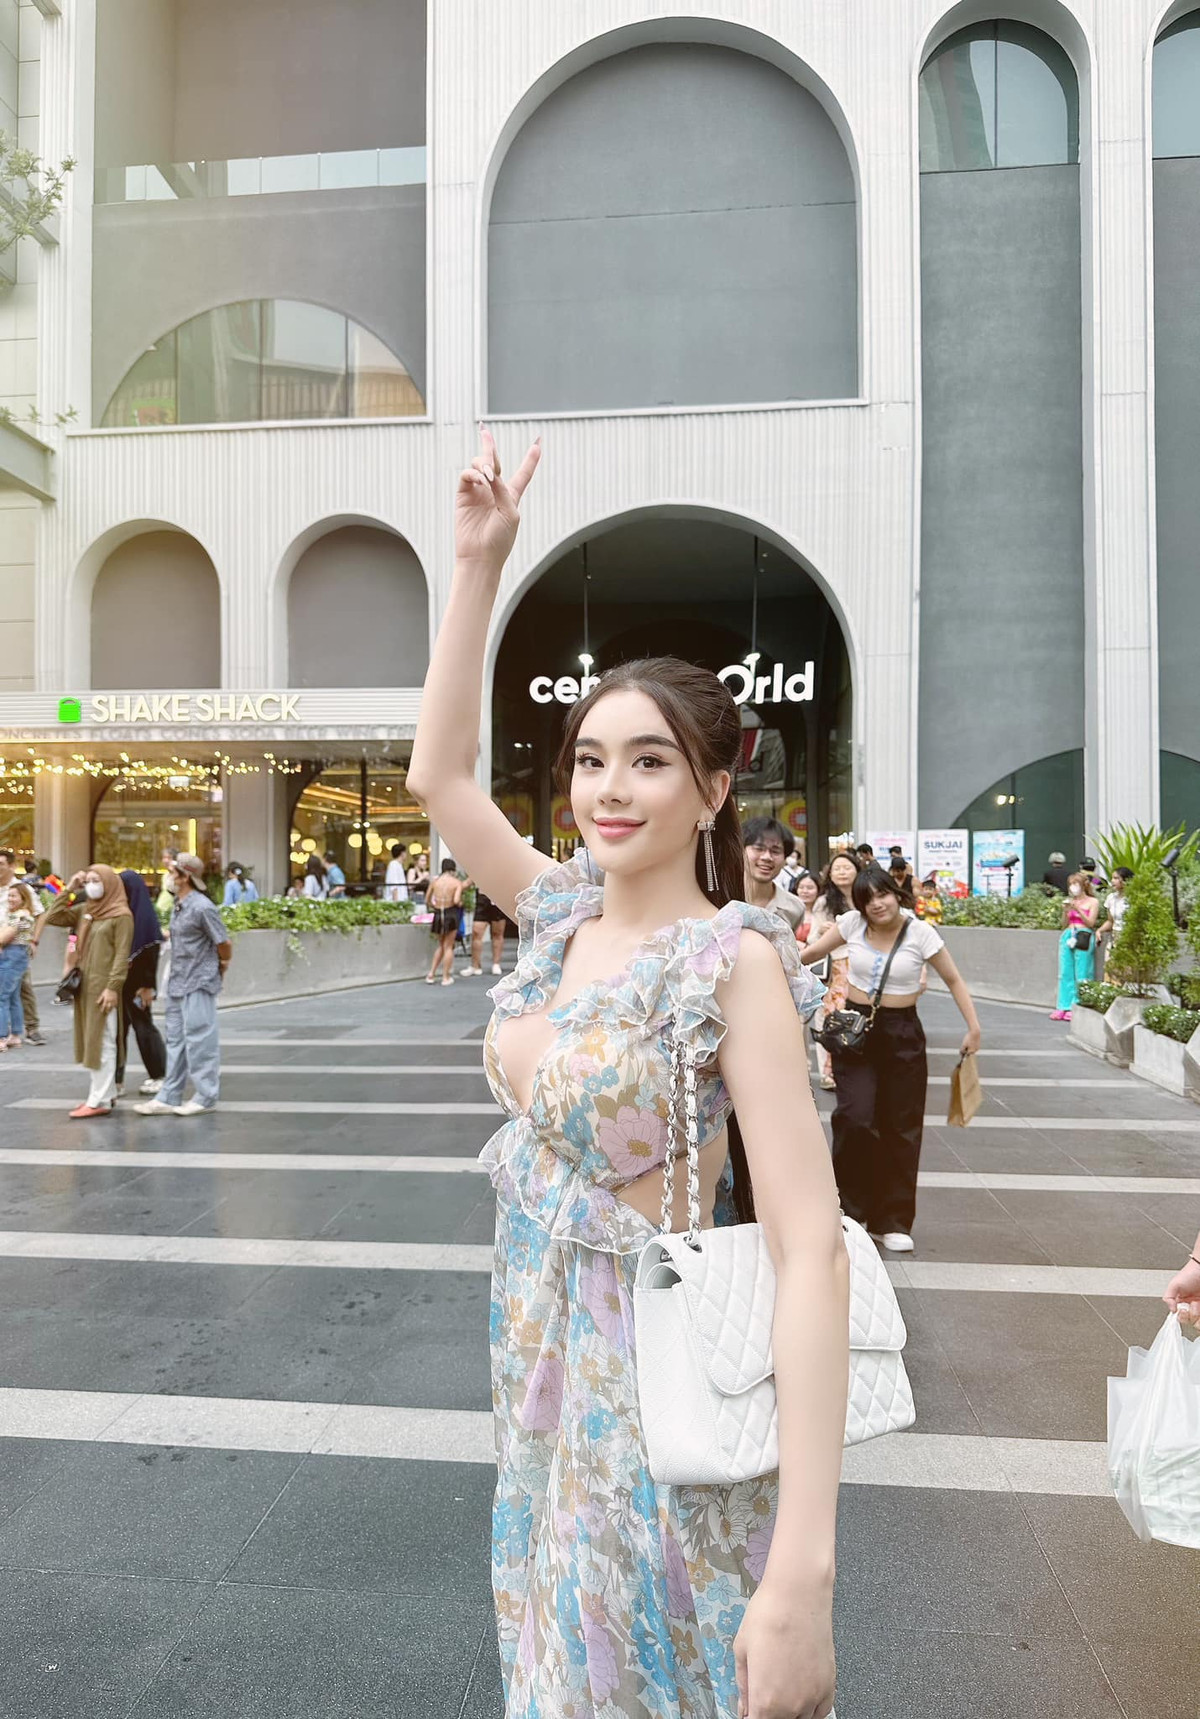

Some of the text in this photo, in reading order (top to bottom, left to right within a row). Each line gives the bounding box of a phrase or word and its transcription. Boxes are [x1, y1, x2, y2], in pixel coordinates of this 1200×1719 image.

[716, 661, 815, 706] Orld
[90, 693, 302, 723] SHAKE SHACK
[924, 841, 963, 849] SUKJAI
